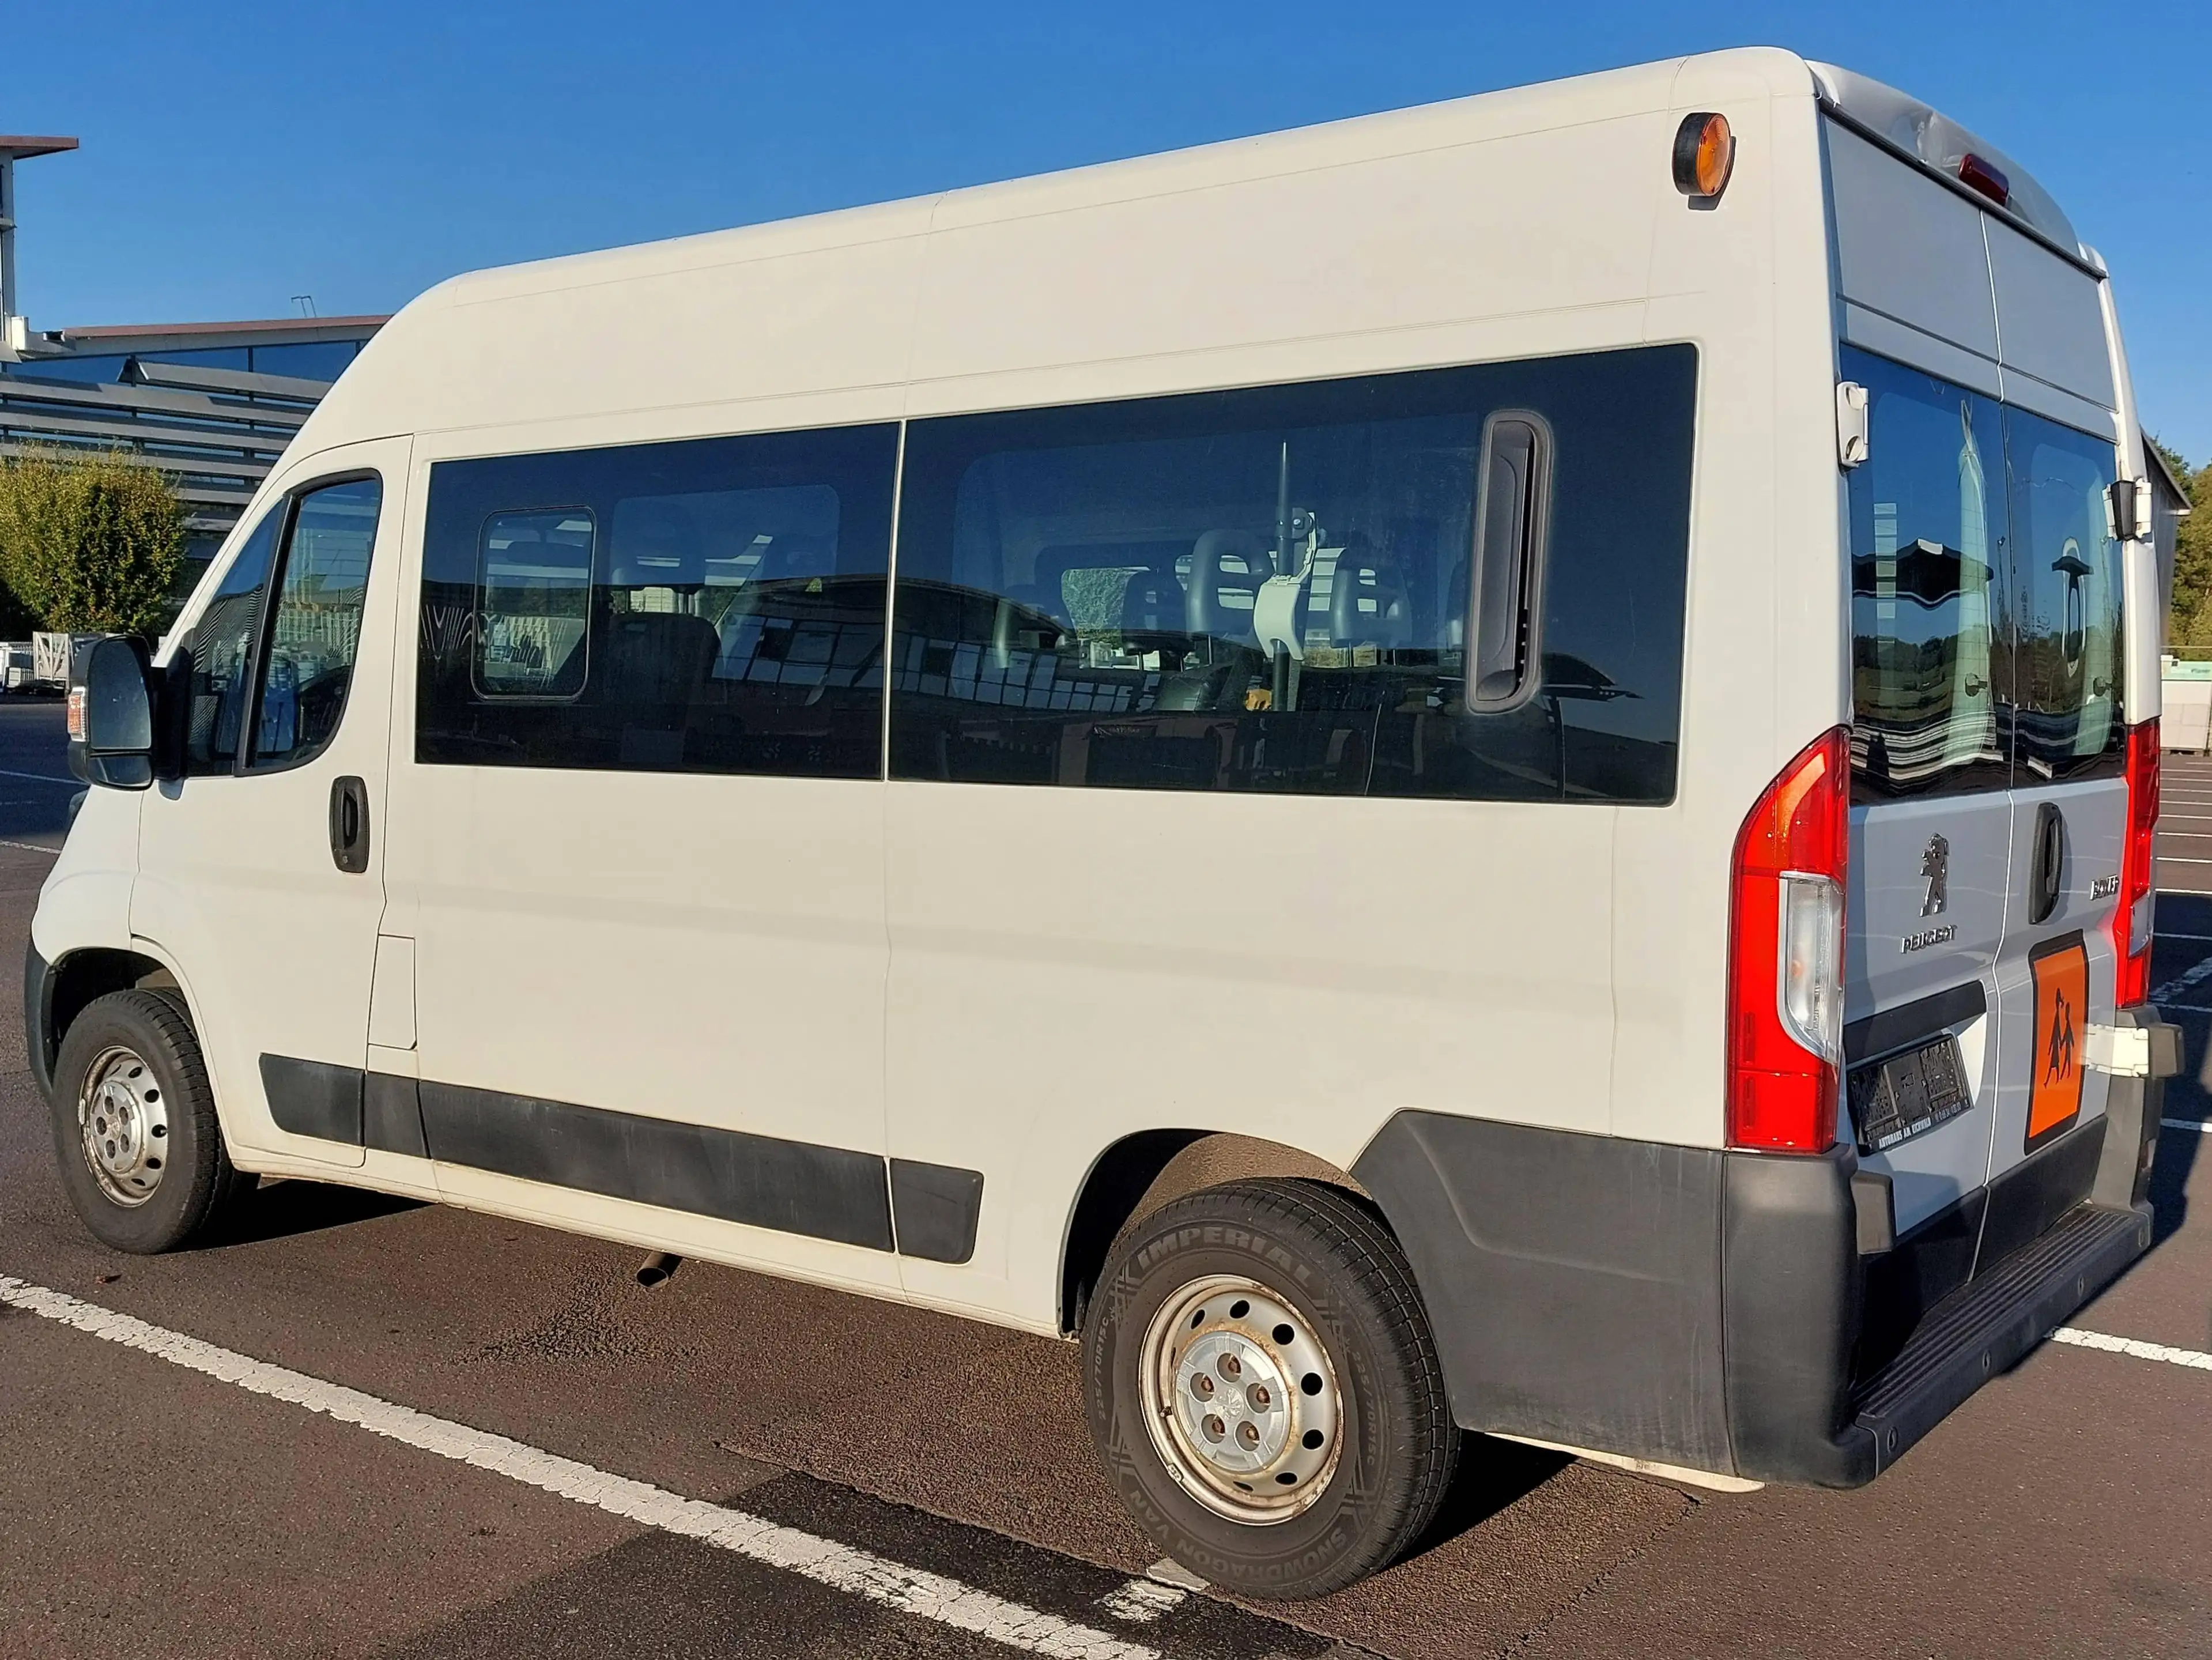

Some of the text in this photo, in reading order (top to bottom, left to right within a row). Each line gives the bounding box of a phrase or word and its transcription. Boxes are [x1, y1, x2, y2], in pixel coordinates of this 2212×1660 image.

[1901, 925, 1957, 954] PEUGEOT
[1137, 1226, 1311, 1288] IMPERIAL
[1130, 1490, 1349, 1580] SNOWDRAGON VAN
